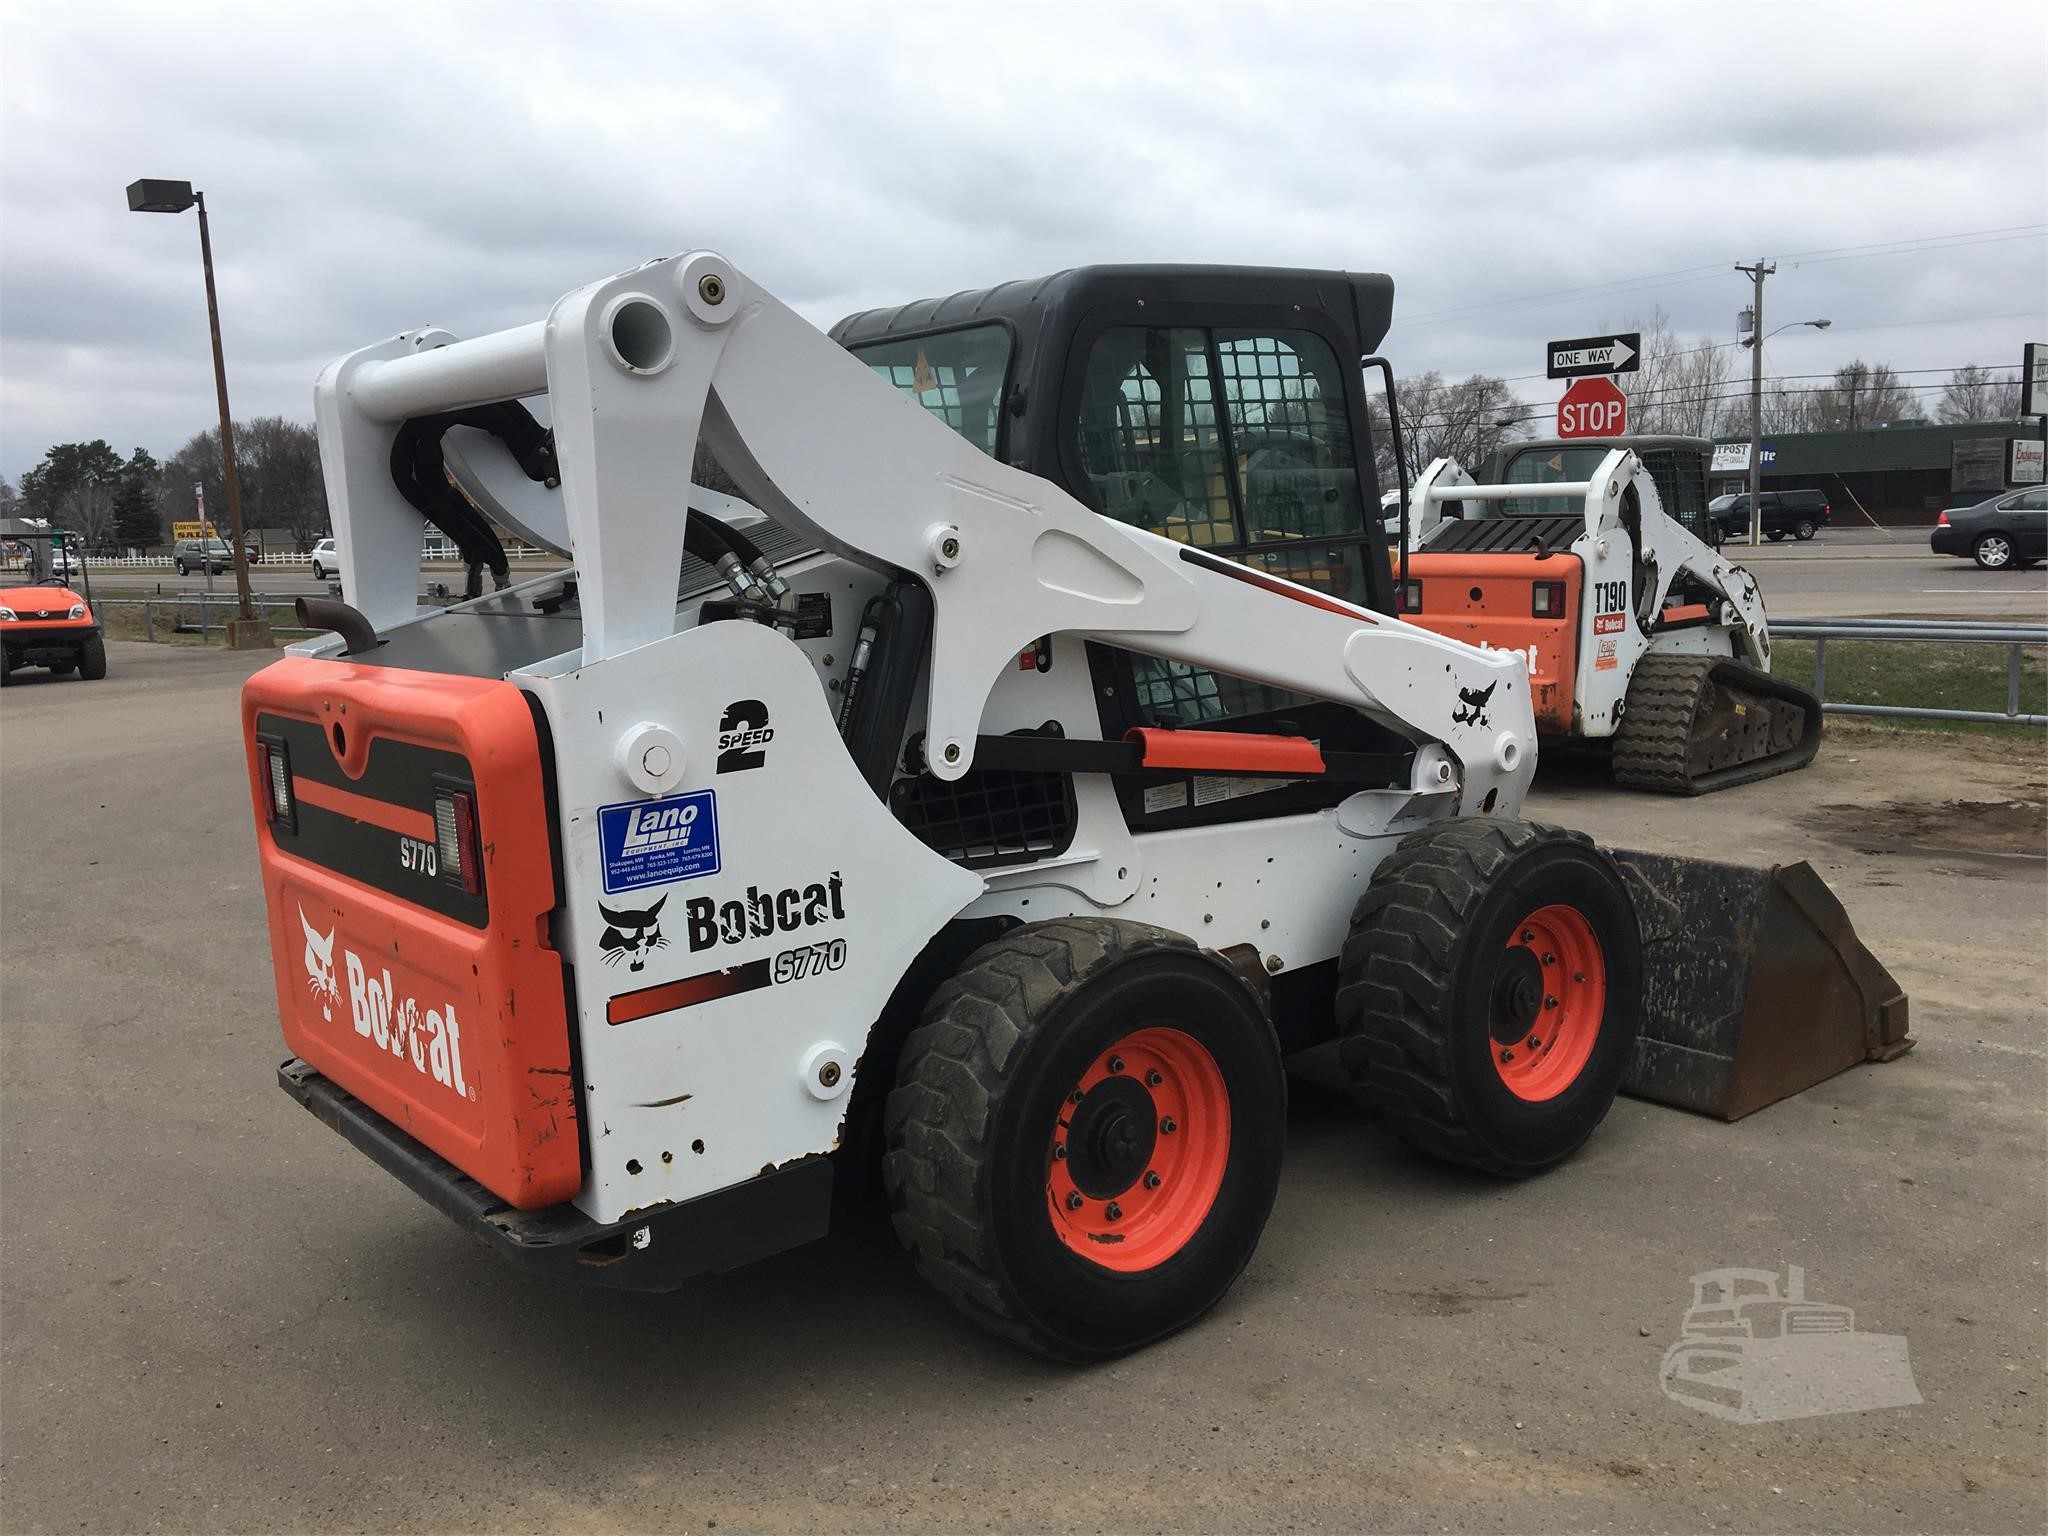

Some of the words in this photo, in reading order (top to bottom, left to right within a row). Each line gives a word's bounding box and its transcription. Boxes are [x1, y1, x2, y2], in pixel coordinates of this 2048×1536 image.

[1557, 352, 1580, 366] ONE
[1588, 349, 1613, 363] WAY
[1561, 400, 1622, 433] STOP
[1715, 444, 1748, 456] TPOST
[1760, 449, 1777, 464] ite
[1594, 580, 1627, 614] T190
[1605, 618, 1624, 631] Bobcat
[718, 728, 775, 751] SPEED
[623, 804, 699, 848] Lano
[401, 837, 437, 877] S770
[626, 863, 701, 883] www.lanoequip.com
[685, 870, 846, 953] Bobcat
[774, 937, 847, 984] S770
[344, 949, 467, 1098] Bobcat
